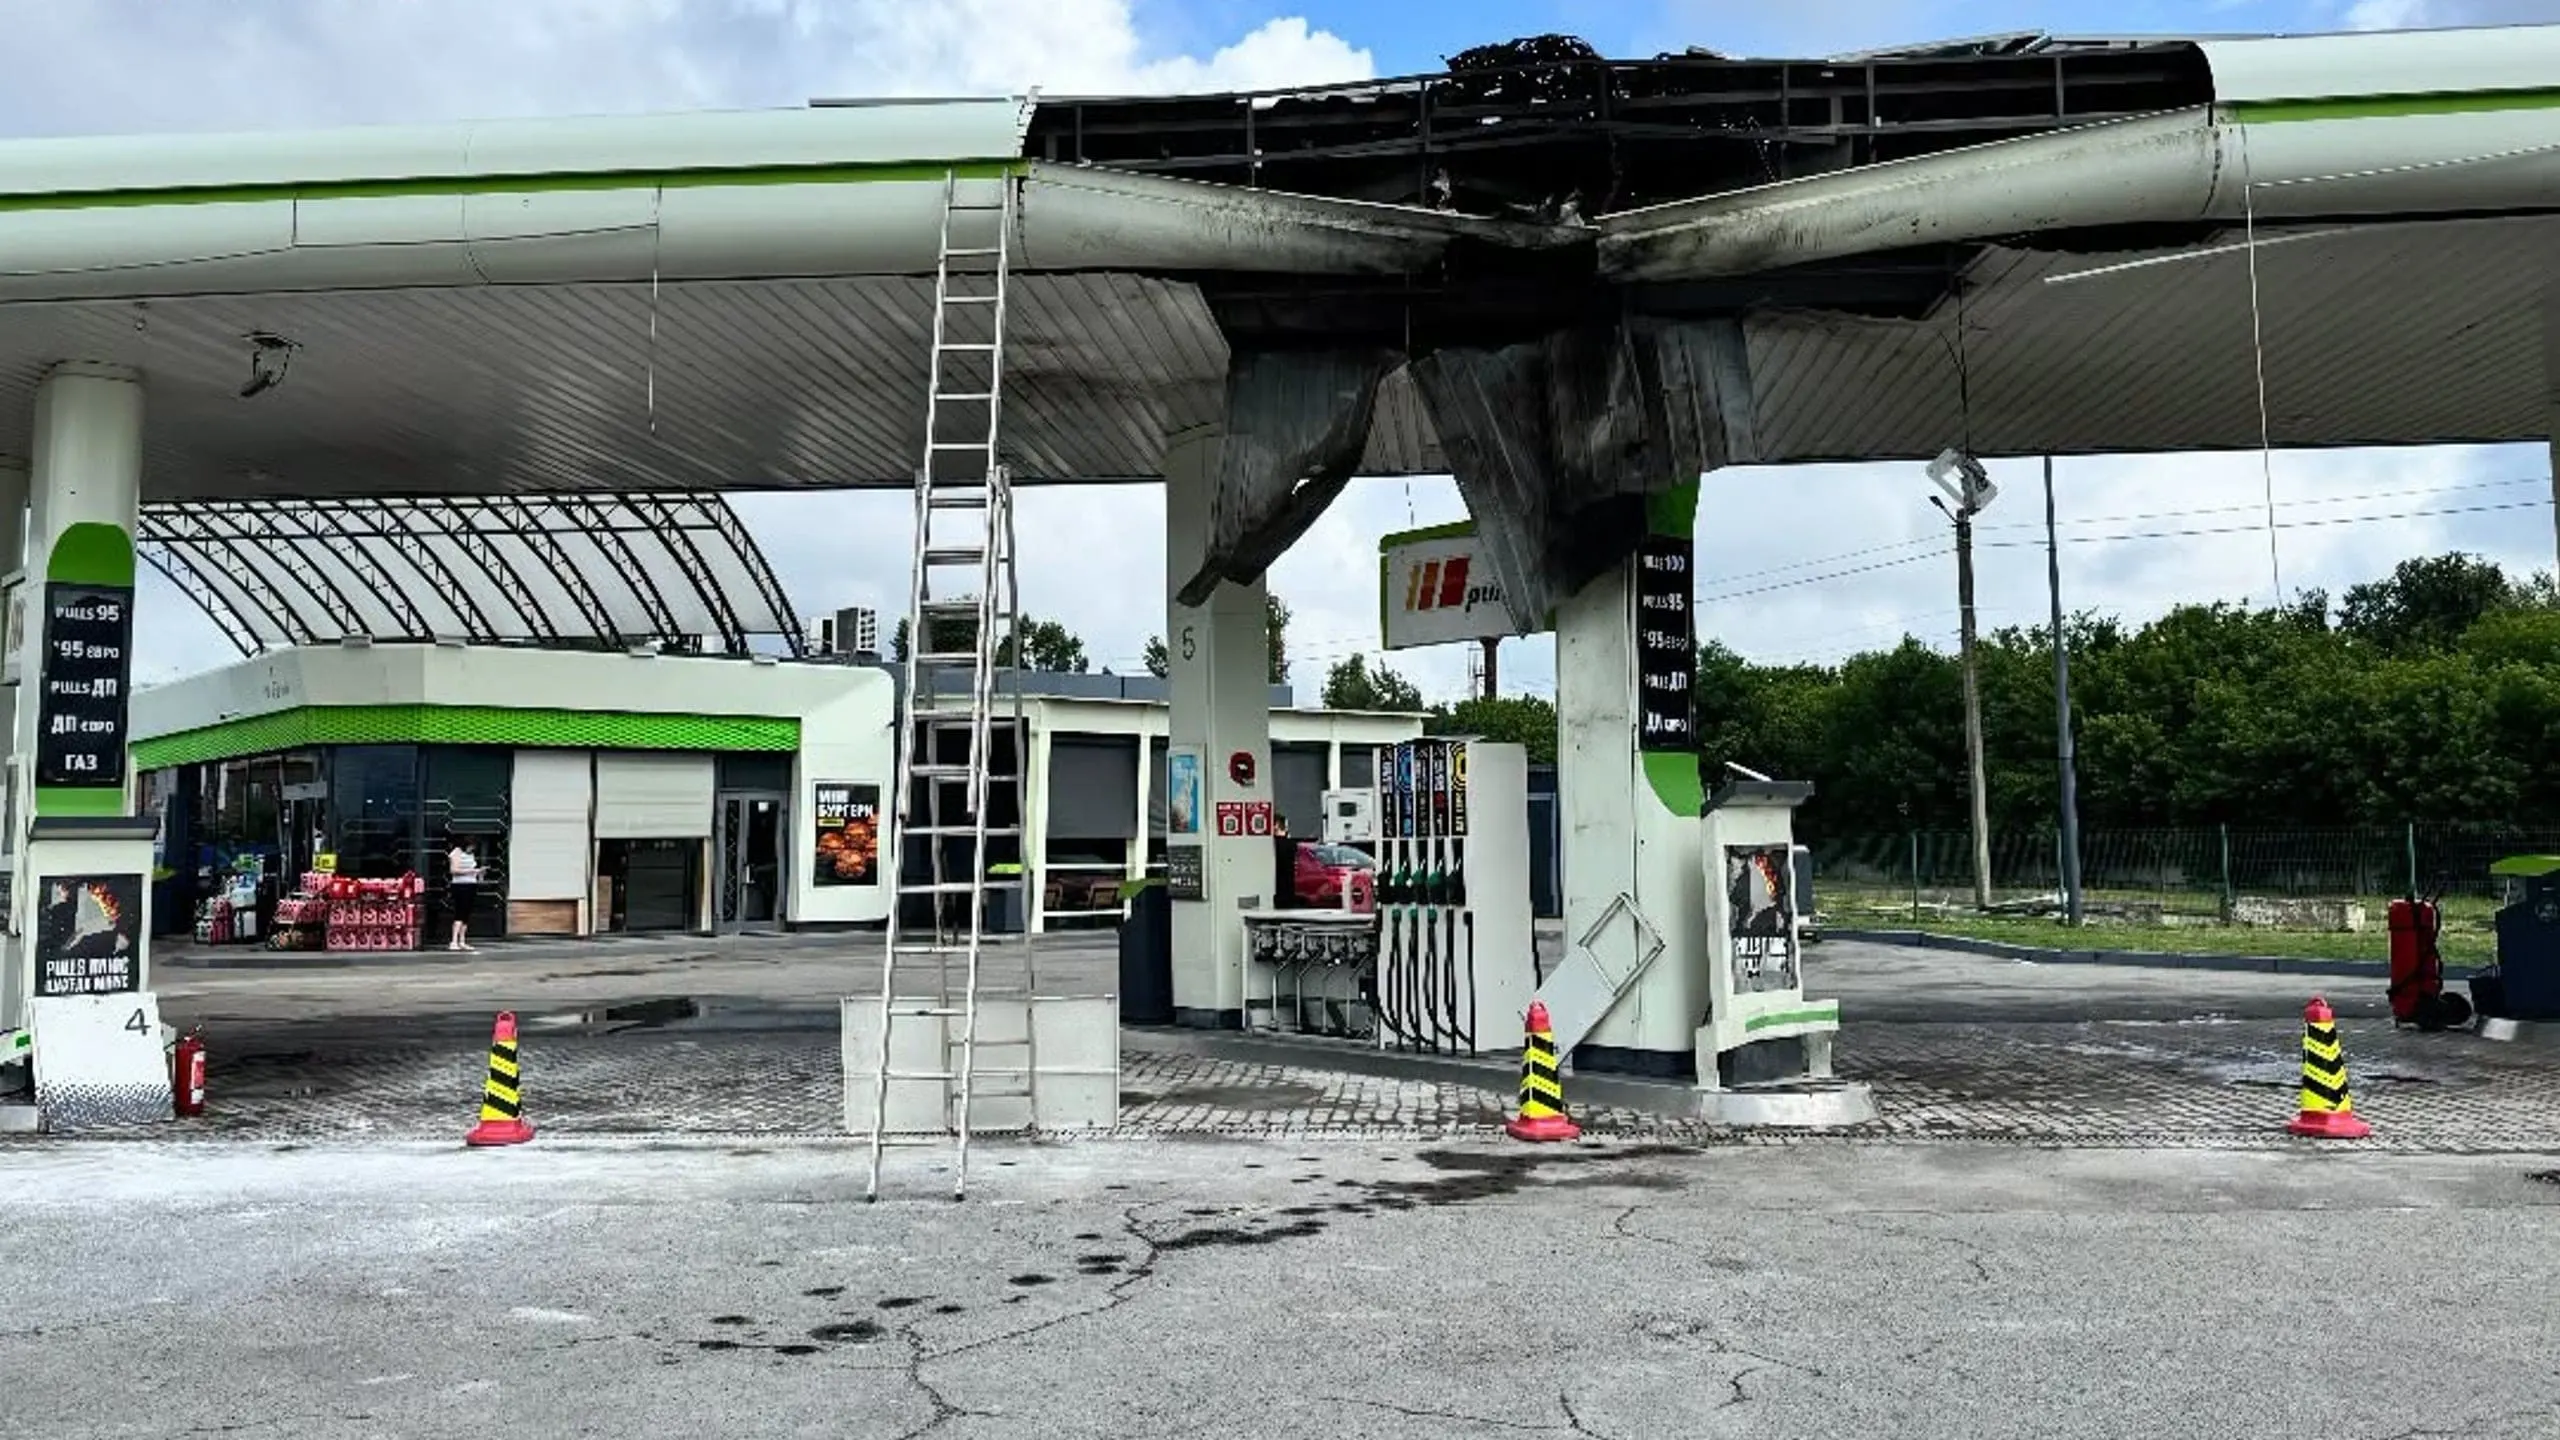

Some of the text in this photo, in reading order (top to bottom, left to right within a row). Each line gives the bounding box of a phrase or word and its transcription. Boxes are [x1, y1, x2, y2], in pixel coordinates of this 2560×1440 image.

[1669, 593, 1684, 611] 95
[56, 605, 119, 621] PULLS 95
[1182, 626, 1196, 660] 5
[51, 678, 117, 698] PULLS ДП
[51, 714, 77, 734] ДП
[65, 754, 98, 771] ГАЗ
[817, 804, 873, 817] БУРГЕРИ
[46, 958, 85, 976] PULLS
[124, 1007, 152, 1036] 4
